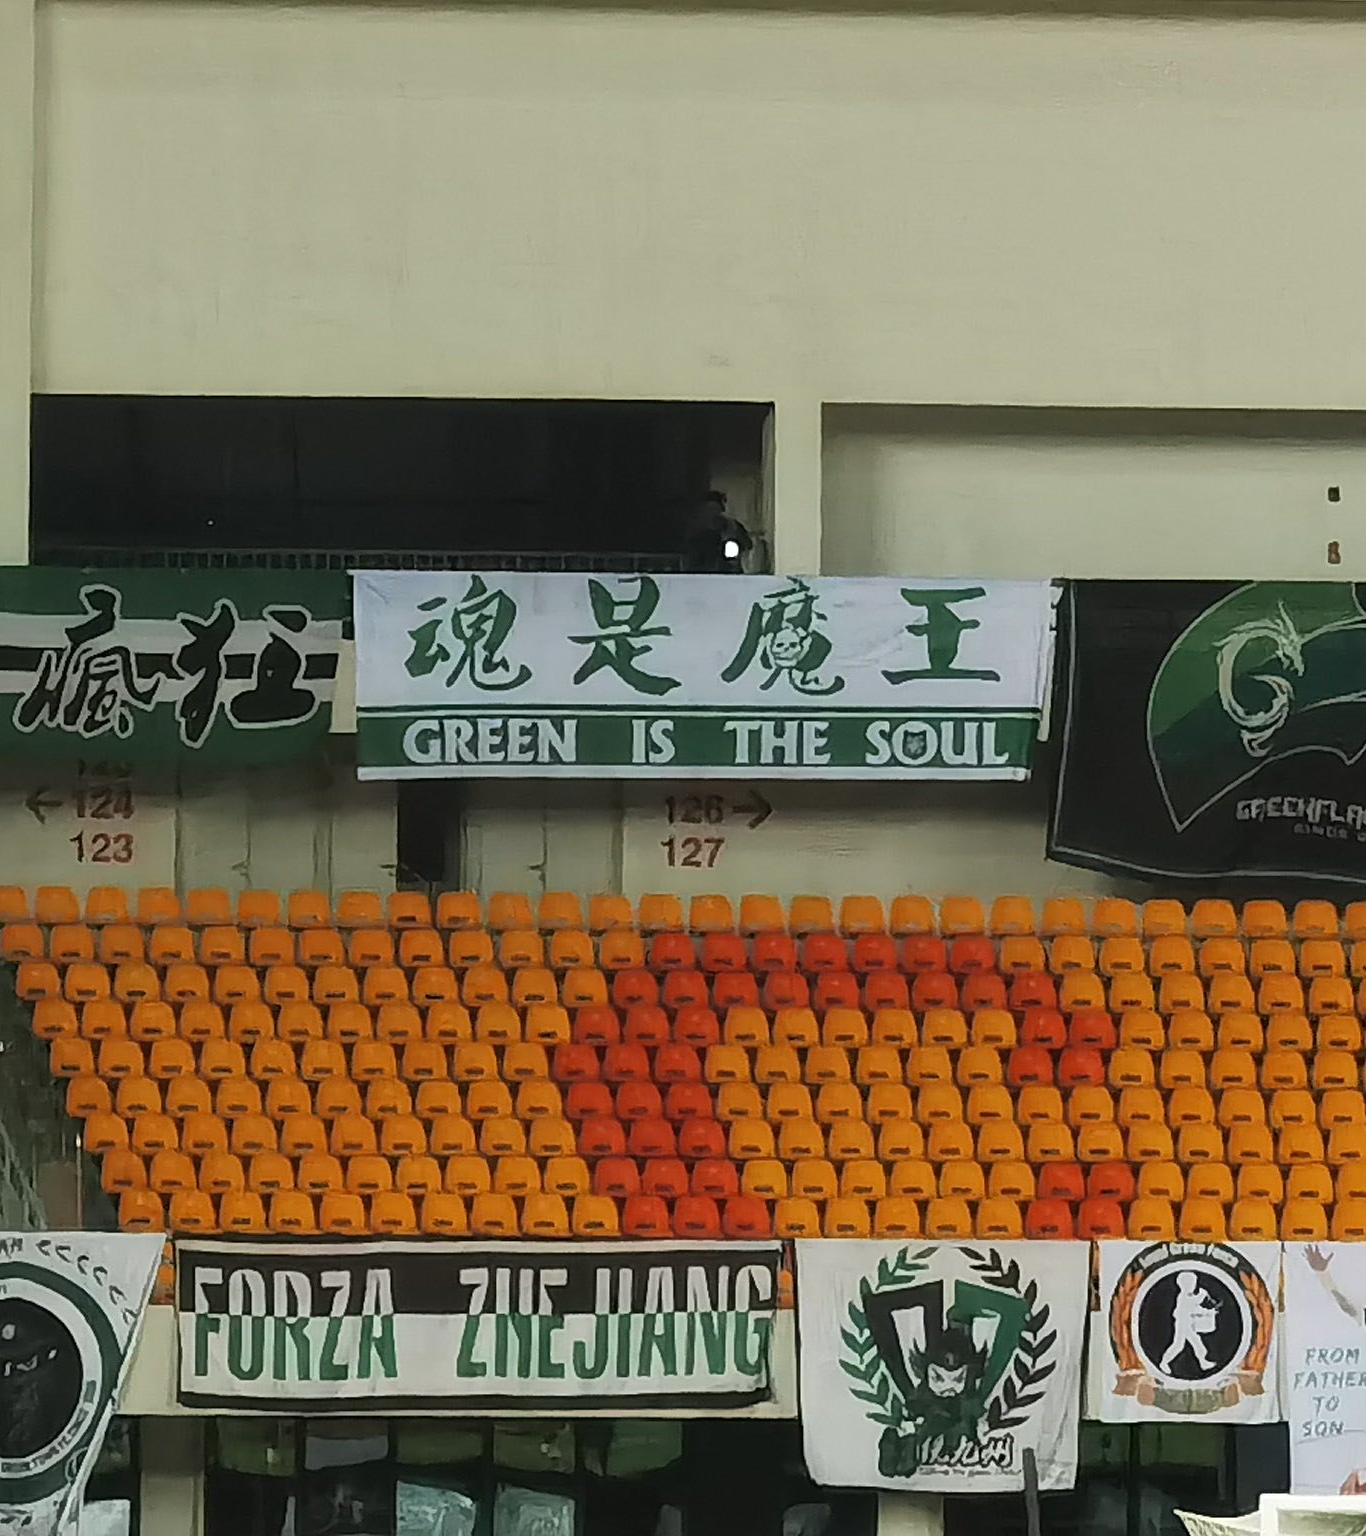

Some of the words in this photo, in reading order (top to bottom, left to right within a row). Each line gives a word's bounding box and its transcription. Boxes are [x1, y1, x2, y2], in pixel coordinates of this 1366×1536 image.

[403, 574, 1001, 698] 魂是魔王
[403, 718, 579, 765] GREEN
[631, 718, 676, 765] IS
[723, 718, 832, 767] THE
[864, 719, 1010, 767] SOUL
[69, 830, 134, 863] 123
[660, 836, 725, 868] 127
[193, 1267, 399, 1381] FORZA
[455, 1266, 773, 1378] ZHEJIANG
[1306, 1348, 1361, 1366] FROM
[1313, 1396, 1340, 1414] TO
